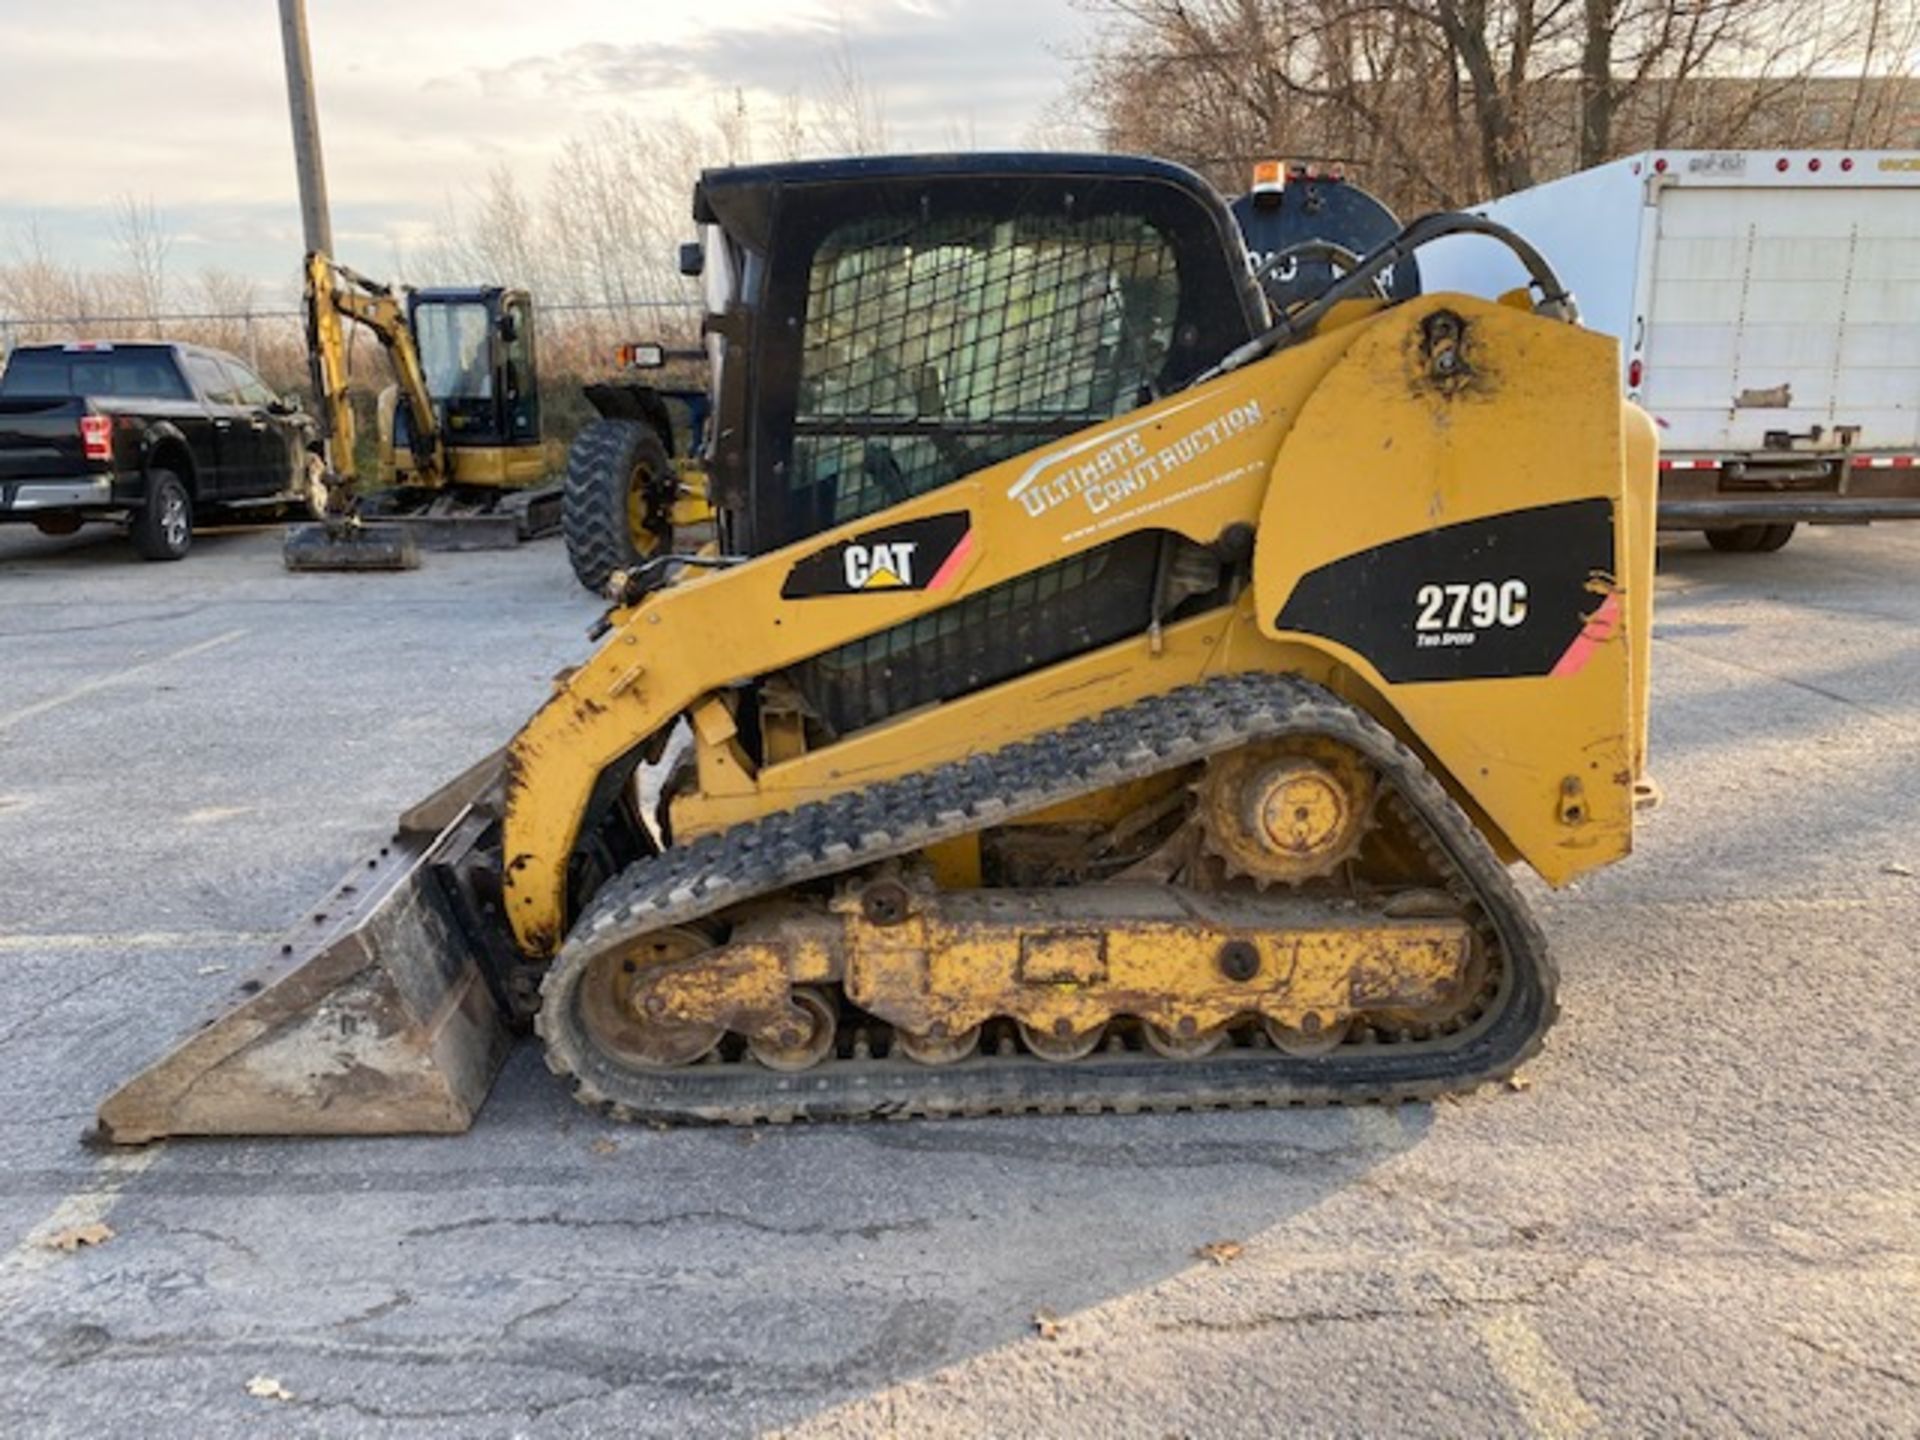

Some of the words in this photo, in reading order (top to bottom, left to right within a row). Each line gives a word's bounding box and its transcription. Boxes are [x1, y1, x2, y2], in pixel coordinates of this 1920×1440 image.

[1020, 432, 1147, 518] ULTIMATE
[843, 542, 917, 588] CAT
[1415, 579, 1528, 631] 279C
